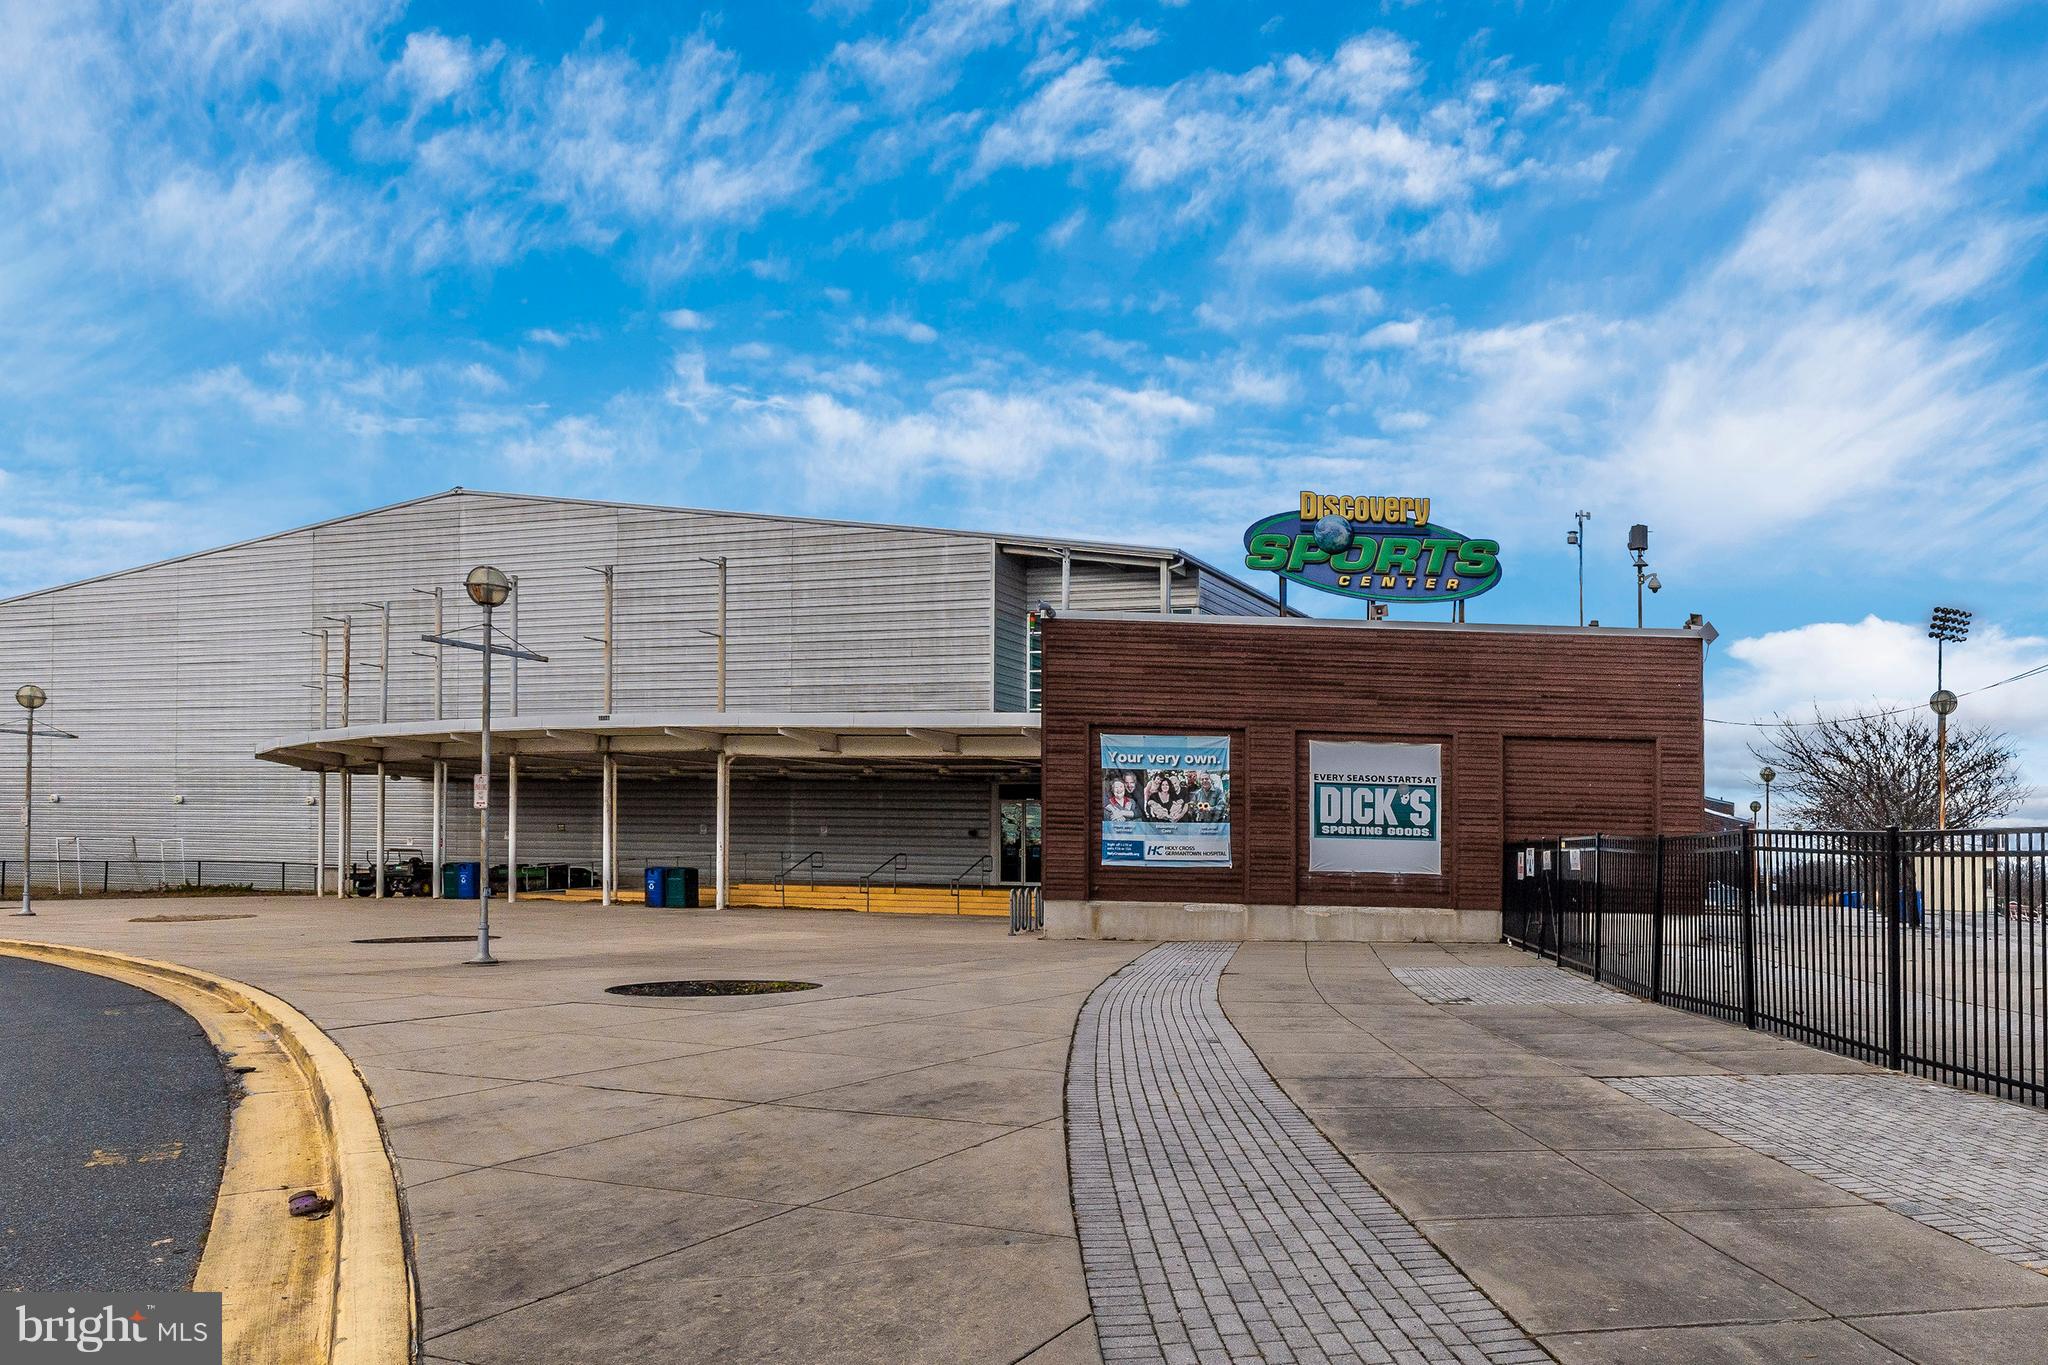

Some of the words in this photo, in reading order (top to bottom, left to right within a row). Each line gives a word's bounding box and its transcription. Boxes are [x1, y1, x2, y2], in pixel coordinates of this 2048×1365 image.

[1300, 490, 1430, 526] Discovery
[1245, 534, 1500, 577] SPORTS
[1338, 575, 1460, 590] CENTER
[1108, 751, 1144, 764] Your
[1147, 754, 1179, 766] very
[1184, 755, 1221, 765] own.
[1320, 787, 1431, 826] DICK'S
[1322, 826, 1382, 835] SPORTING
